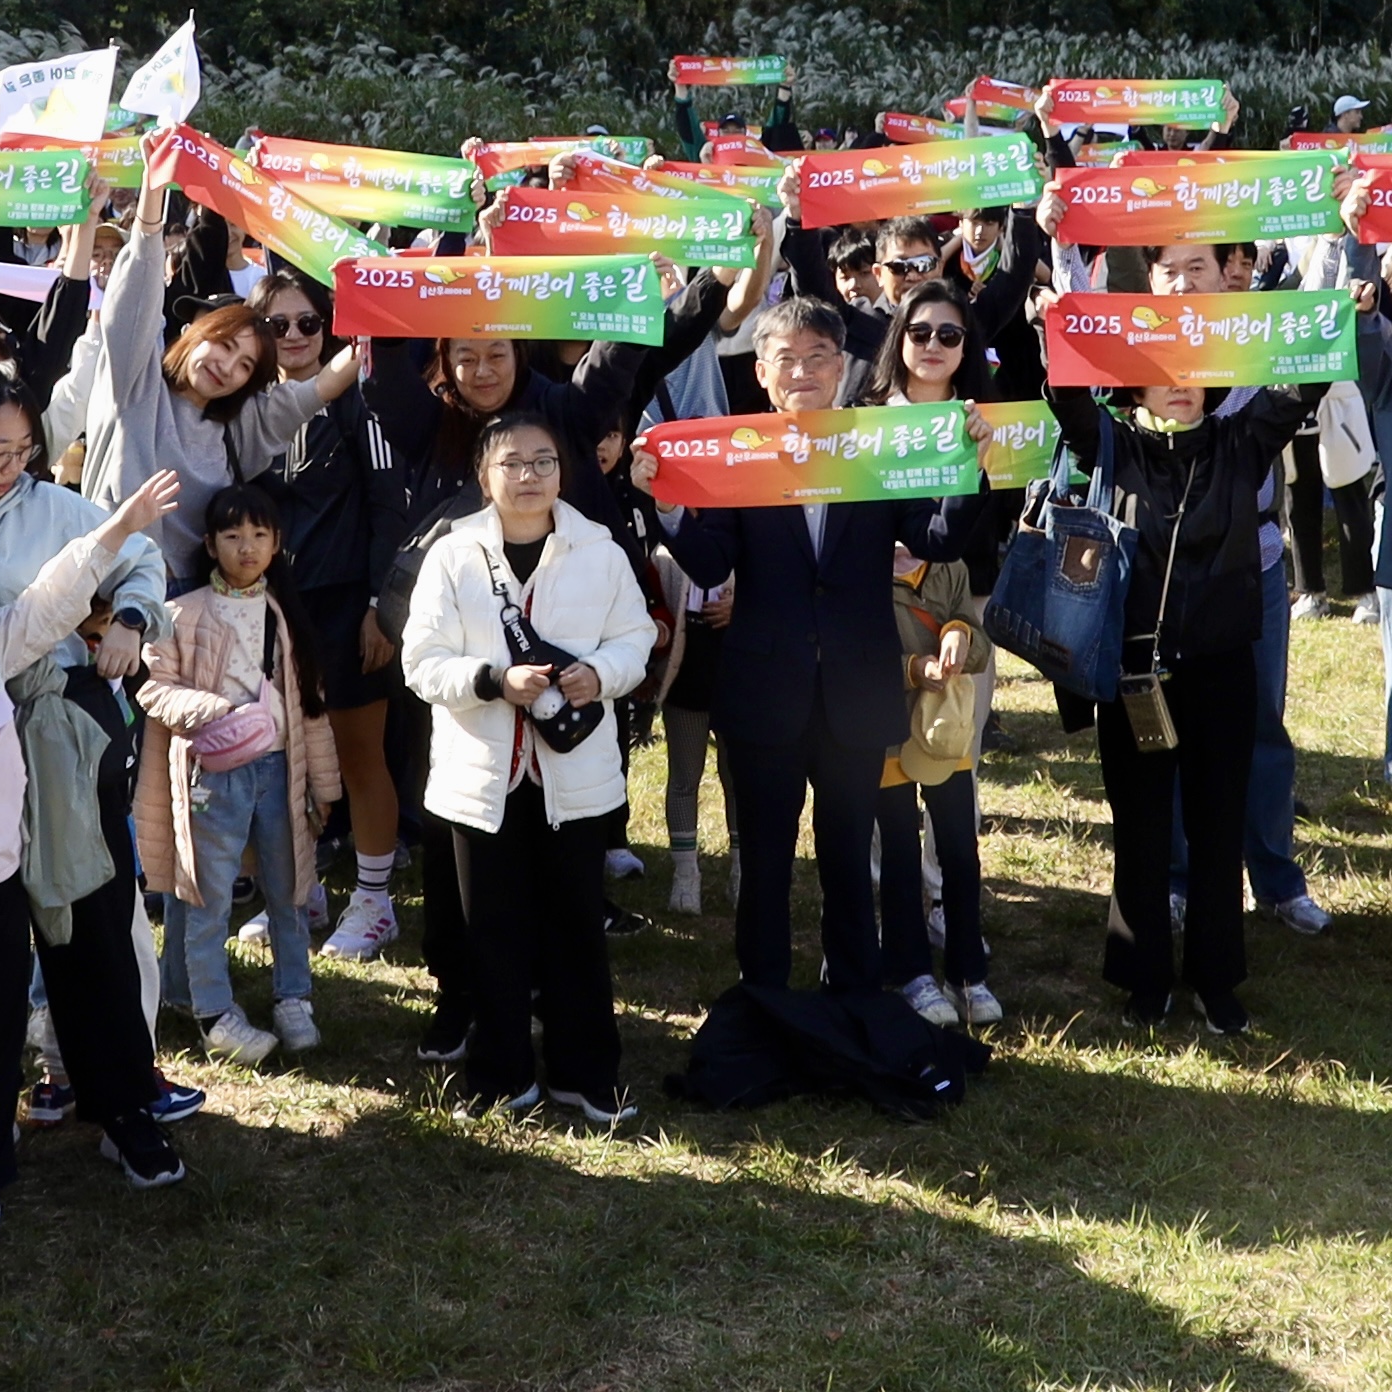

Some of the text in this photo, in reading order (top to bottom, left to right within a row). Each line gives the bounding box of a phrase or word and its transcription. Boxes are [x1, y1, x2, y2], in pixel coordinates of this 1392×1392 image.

[1058, 91, 1090, 102] 2025
[262, 154, 303, 172] 2025
[809, 169, 854, 187] 2025
[899, 154, 975, 185] 함께걸어
[171, 134, 220, 171] 2025
[267, 183, 349, 250] 함께걸어
[1071, 186, 1122, 203] 2025
[1174, 176, 1260, 211] 함께걸어
[507, 206, 557, 224] 2025
[607, 205, 687, 239] 함께걸어
[352, 268, 414, 288] 2025
[475, 264, 574, 301] 함께걸어
[1066, 315, 1121, 334] 2025
[1178, 306, 1271, 347] 함께걸어
[659, 439, 720, 457] 2025
[781, 425, 882, 464] 함께걸어
